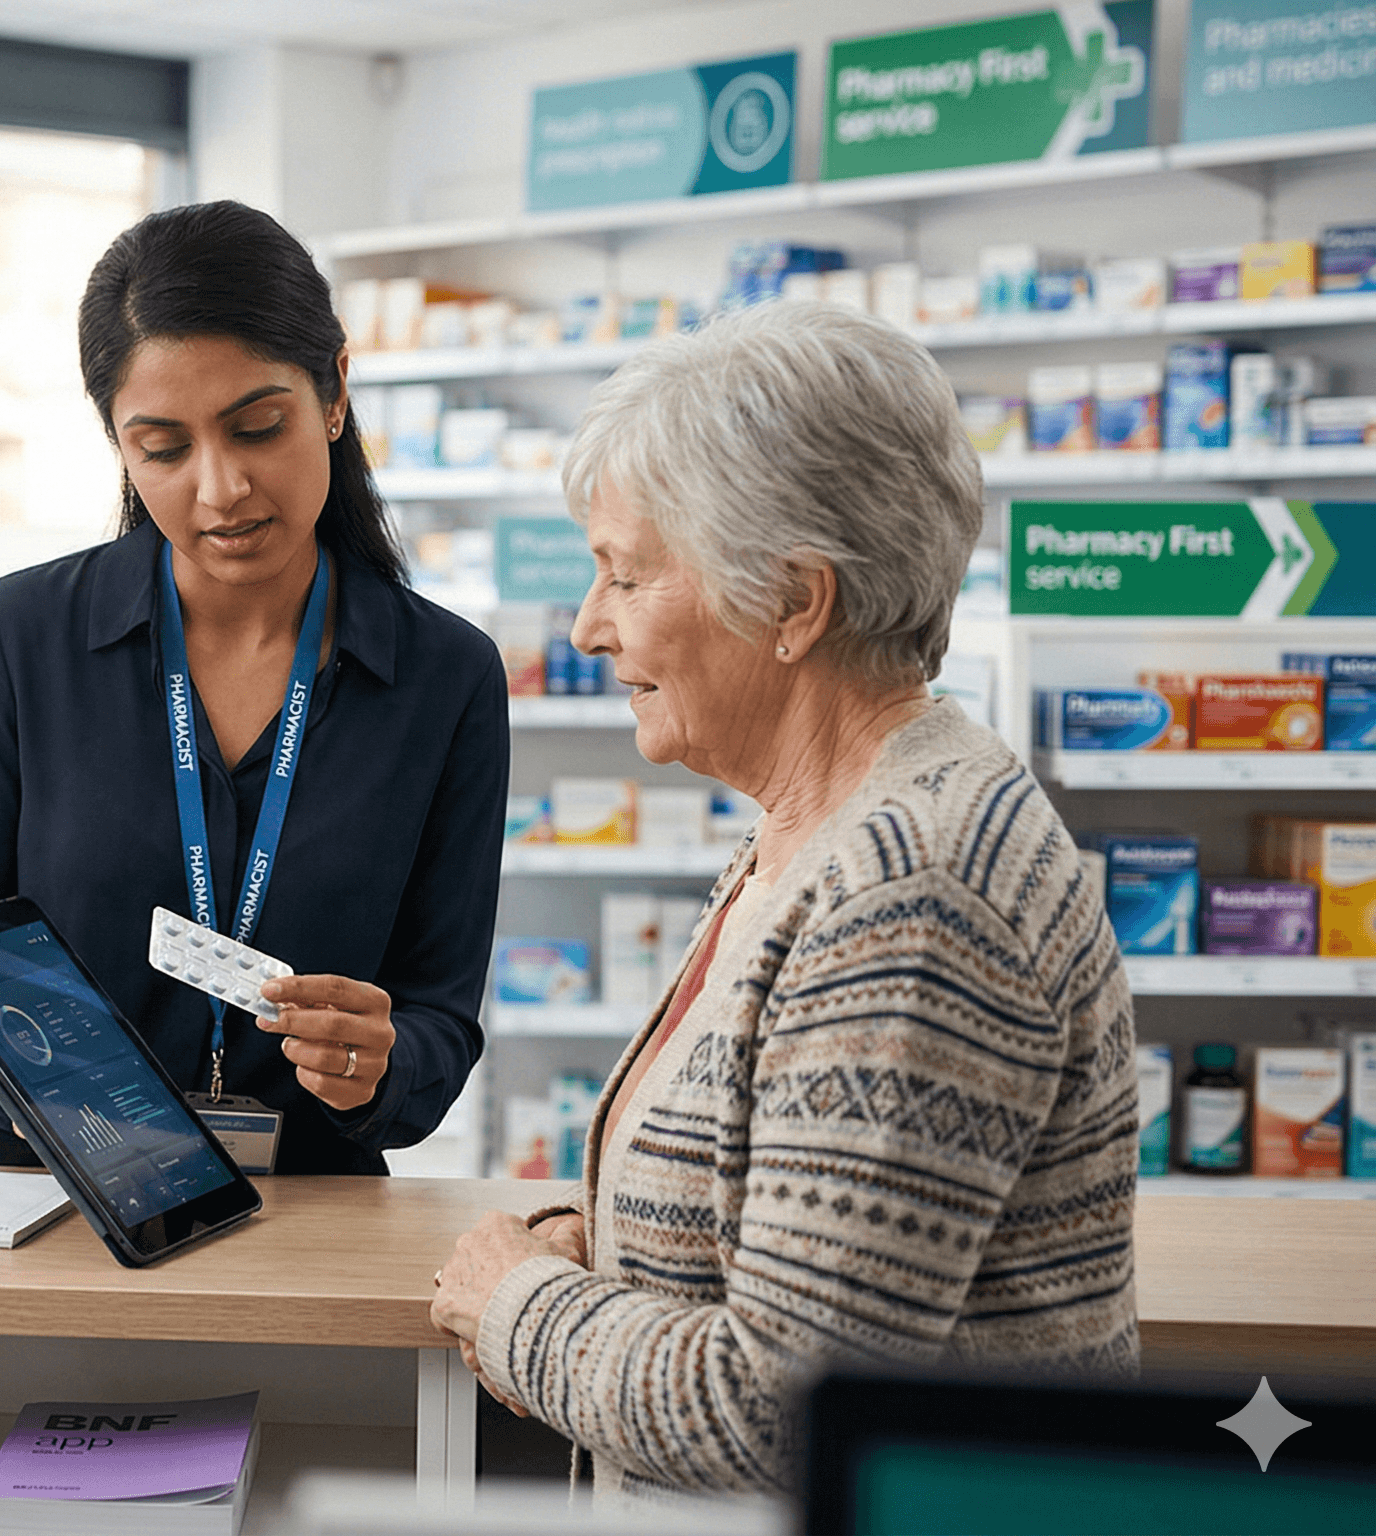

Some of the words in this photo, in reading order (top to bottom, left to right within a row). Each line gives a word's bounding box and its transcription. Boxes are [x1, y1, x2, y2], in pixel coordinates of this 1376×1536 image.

[838, 59, 973, 102] Pharmacy
[978, 46, 1048, 86] First
[1203, 52, 1261, 96] and
[836, 102, 938, 143] service
[1026, 524, 1165, 562] Pharmacy
[1170, 525, 1234, 556] First
[1026, 559, 1122, 591] service
[276, 681, 307, 778] PHARMACIST
[44, 1414, 177, 1432] BNF
[35, 1436, 113, 1451] app
